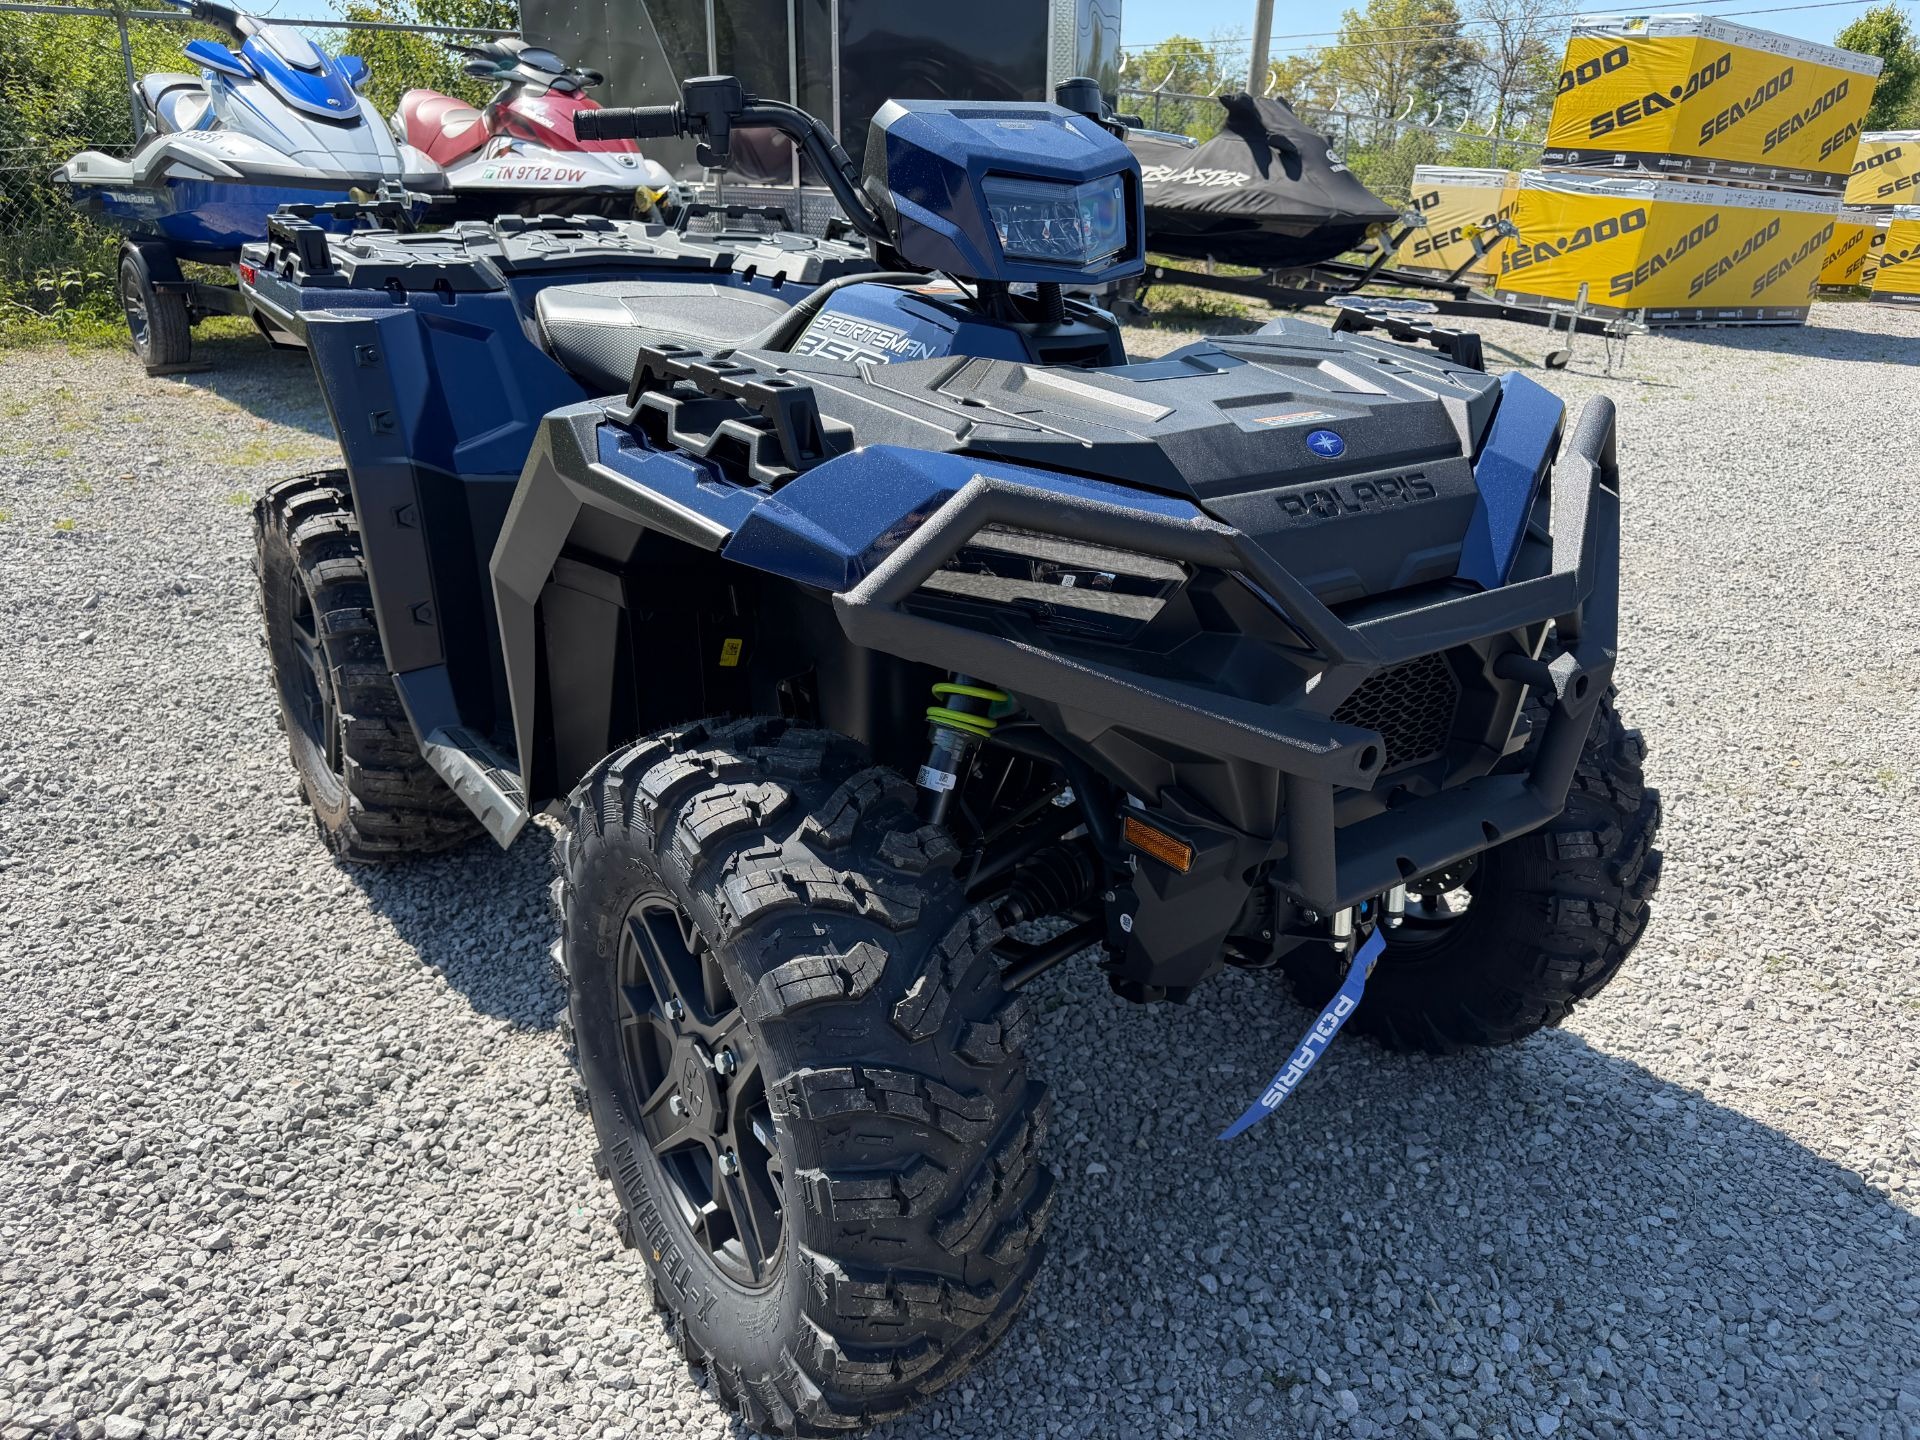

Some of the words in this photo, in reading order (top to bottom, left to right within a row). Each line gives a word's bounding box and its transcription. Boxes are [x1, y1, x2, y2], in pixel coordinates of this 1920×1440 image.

[496, 166, 515, 180] TN
[516, 166, 552, 181] 9712
[554, 168, 587, 183] DW
[812, 313, 936, 360] SPORTSMAN
[1275, 472, 1438, 521] POLARIS
[1261, 994, 1355, 1109] POLARIS
